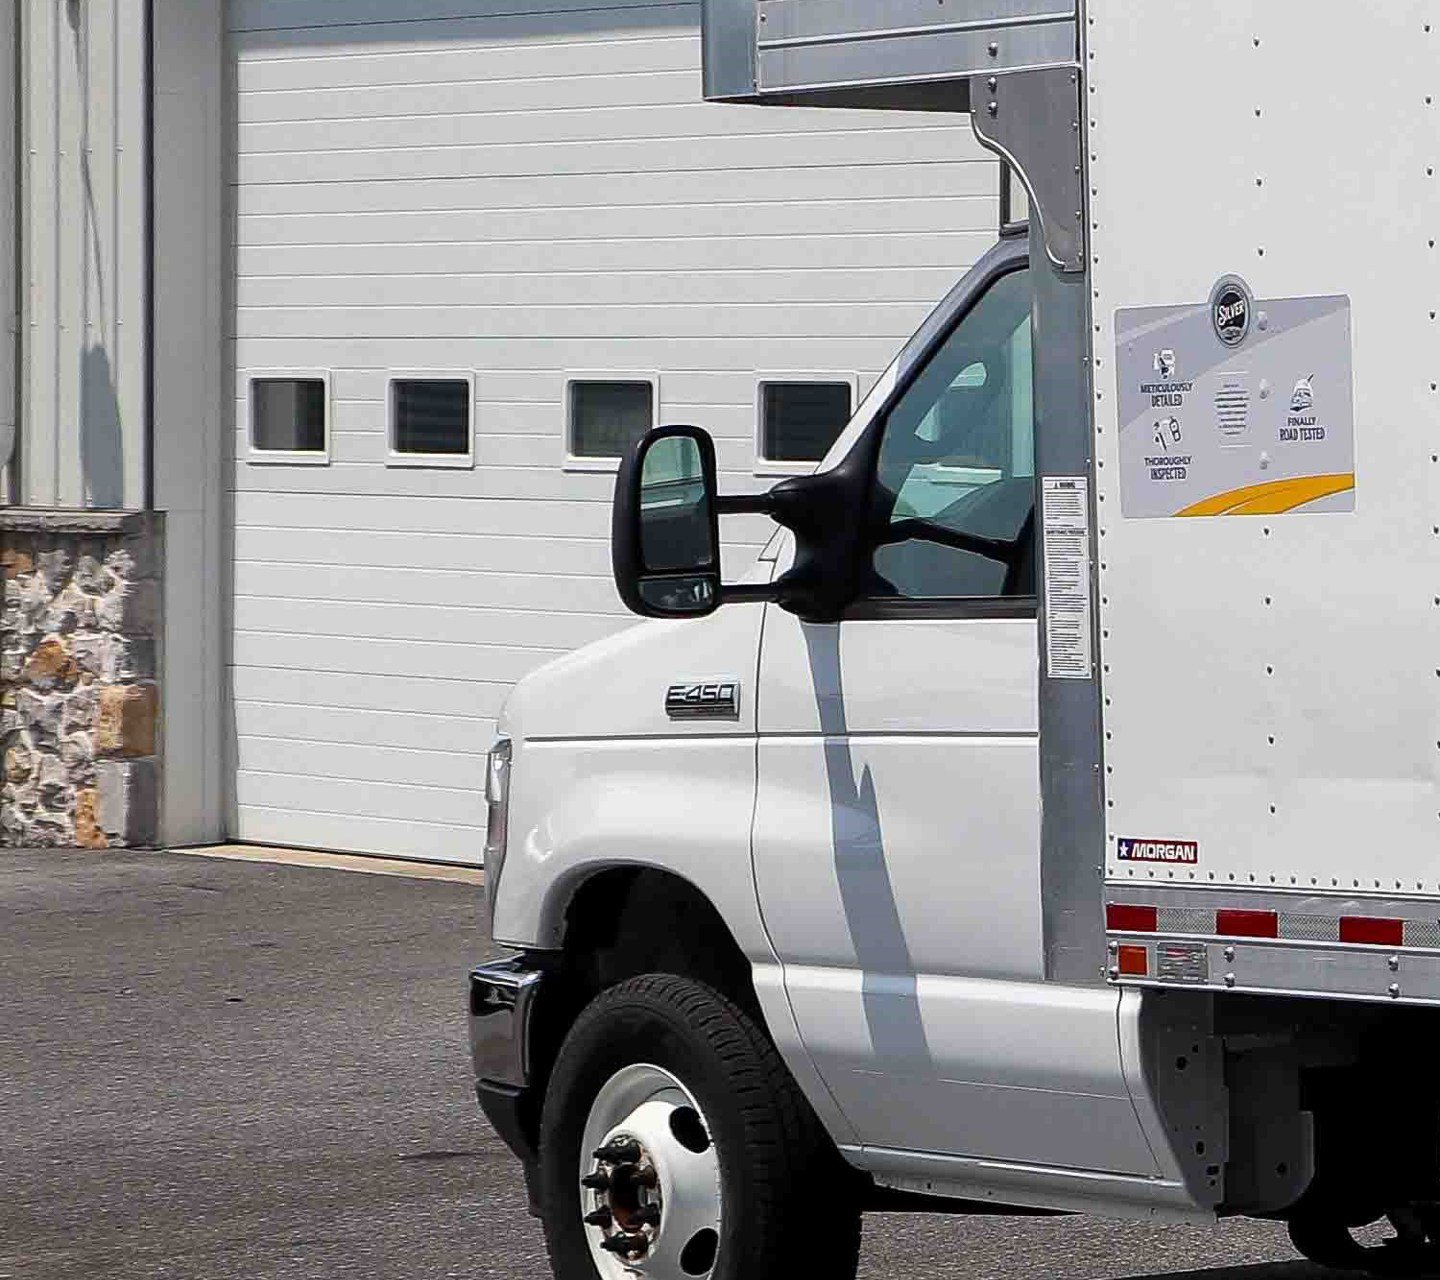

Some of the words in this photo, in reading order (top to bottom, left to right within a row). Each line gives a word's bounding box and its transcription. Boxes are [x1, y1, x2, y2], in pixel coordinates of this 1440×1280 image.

[1218, 301, 1245, 326] SILVER
[1151, 394, 1183, 407] DETAILED
[1287, 417, 1316, 427] FINALLY
[1279, 428, 1299, 441] ROAD
[1299, 426, 1326, 440] TESTED
[1144, 455, 1192, 466] THOROUGHLY
[1132, 843, 1195, 860] MORGAN
